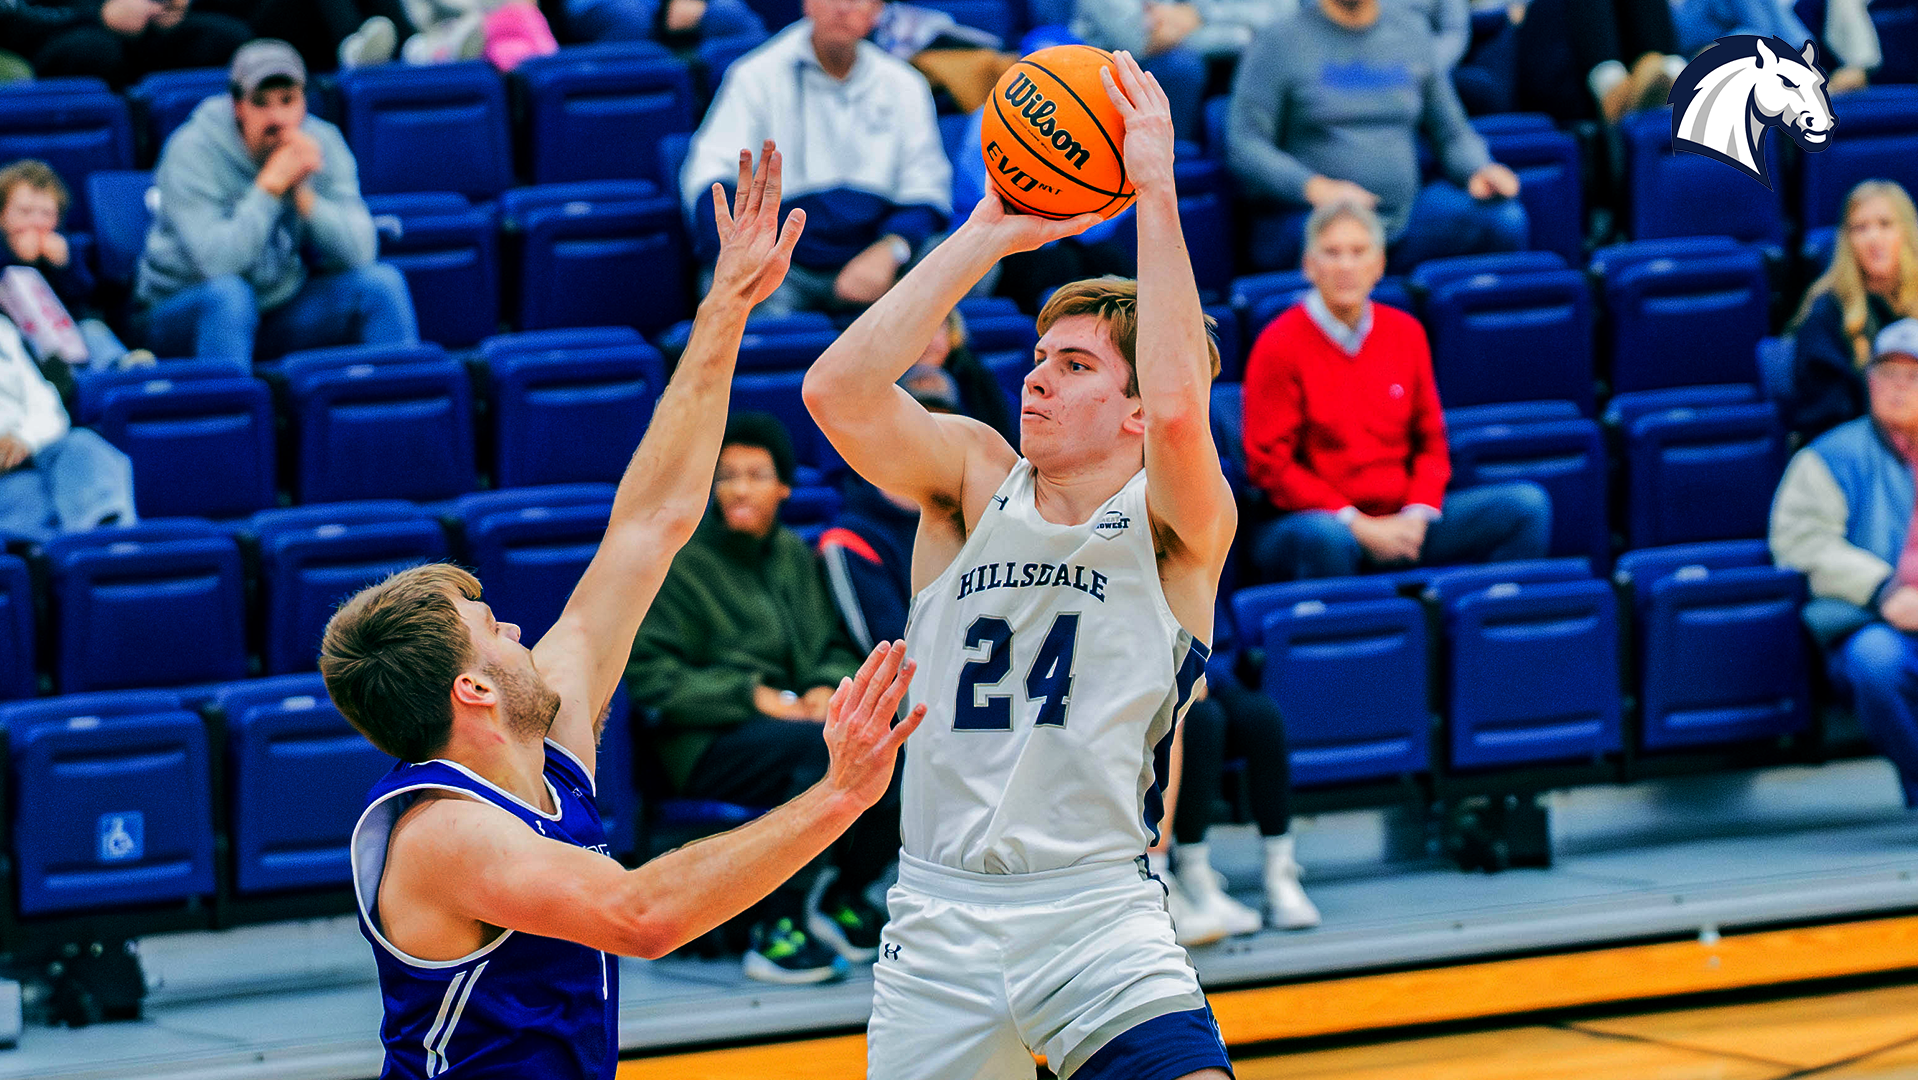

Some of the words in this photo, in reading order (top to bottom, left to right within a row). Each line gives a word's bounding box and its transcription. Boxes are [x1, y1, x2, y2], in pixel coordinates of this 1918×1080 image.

[1004, 71, 1091, 171] Wilson
[986, 140, 1040, 192] EVO
[957, 561, 1108, 603] HILLSDALE
[951, 611, 1082, 732] 24
